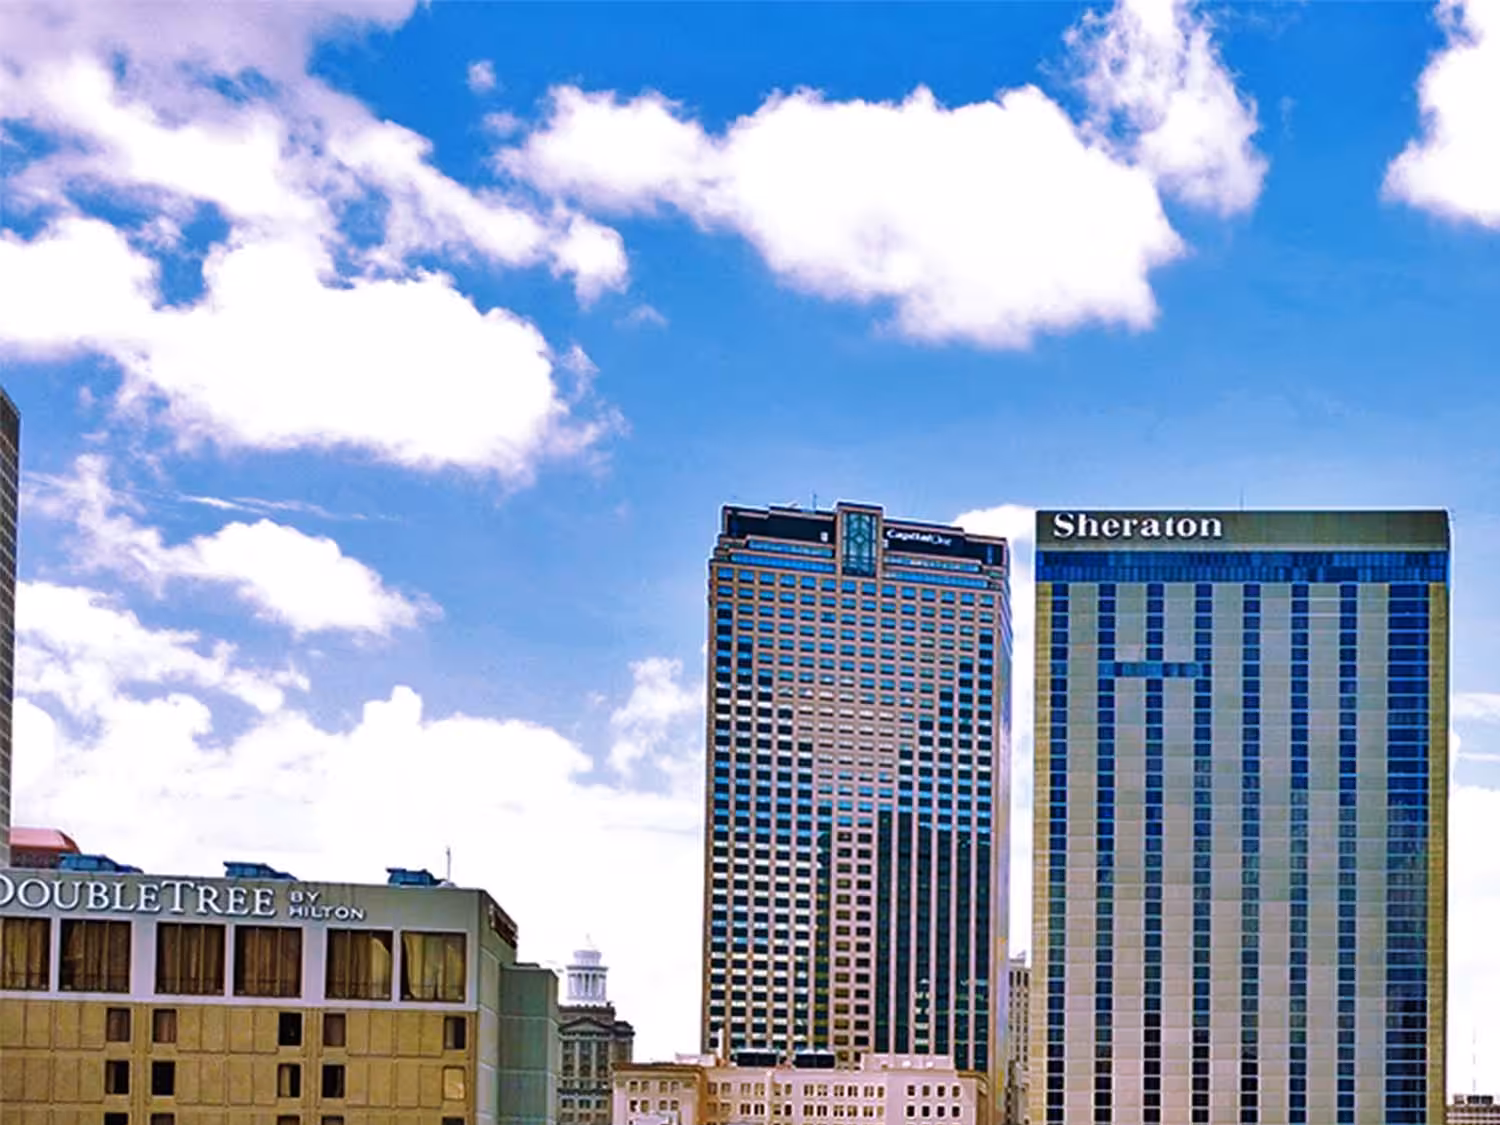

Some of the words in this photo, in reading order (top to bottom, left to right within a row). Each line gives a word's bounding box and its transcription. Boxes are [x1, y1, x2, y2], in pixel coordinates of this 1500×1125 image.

[1053, 512, 1223, 538] Sheraton
[290, 890, 322, 903] BY
[289, 904, 366, 921] HILTON
